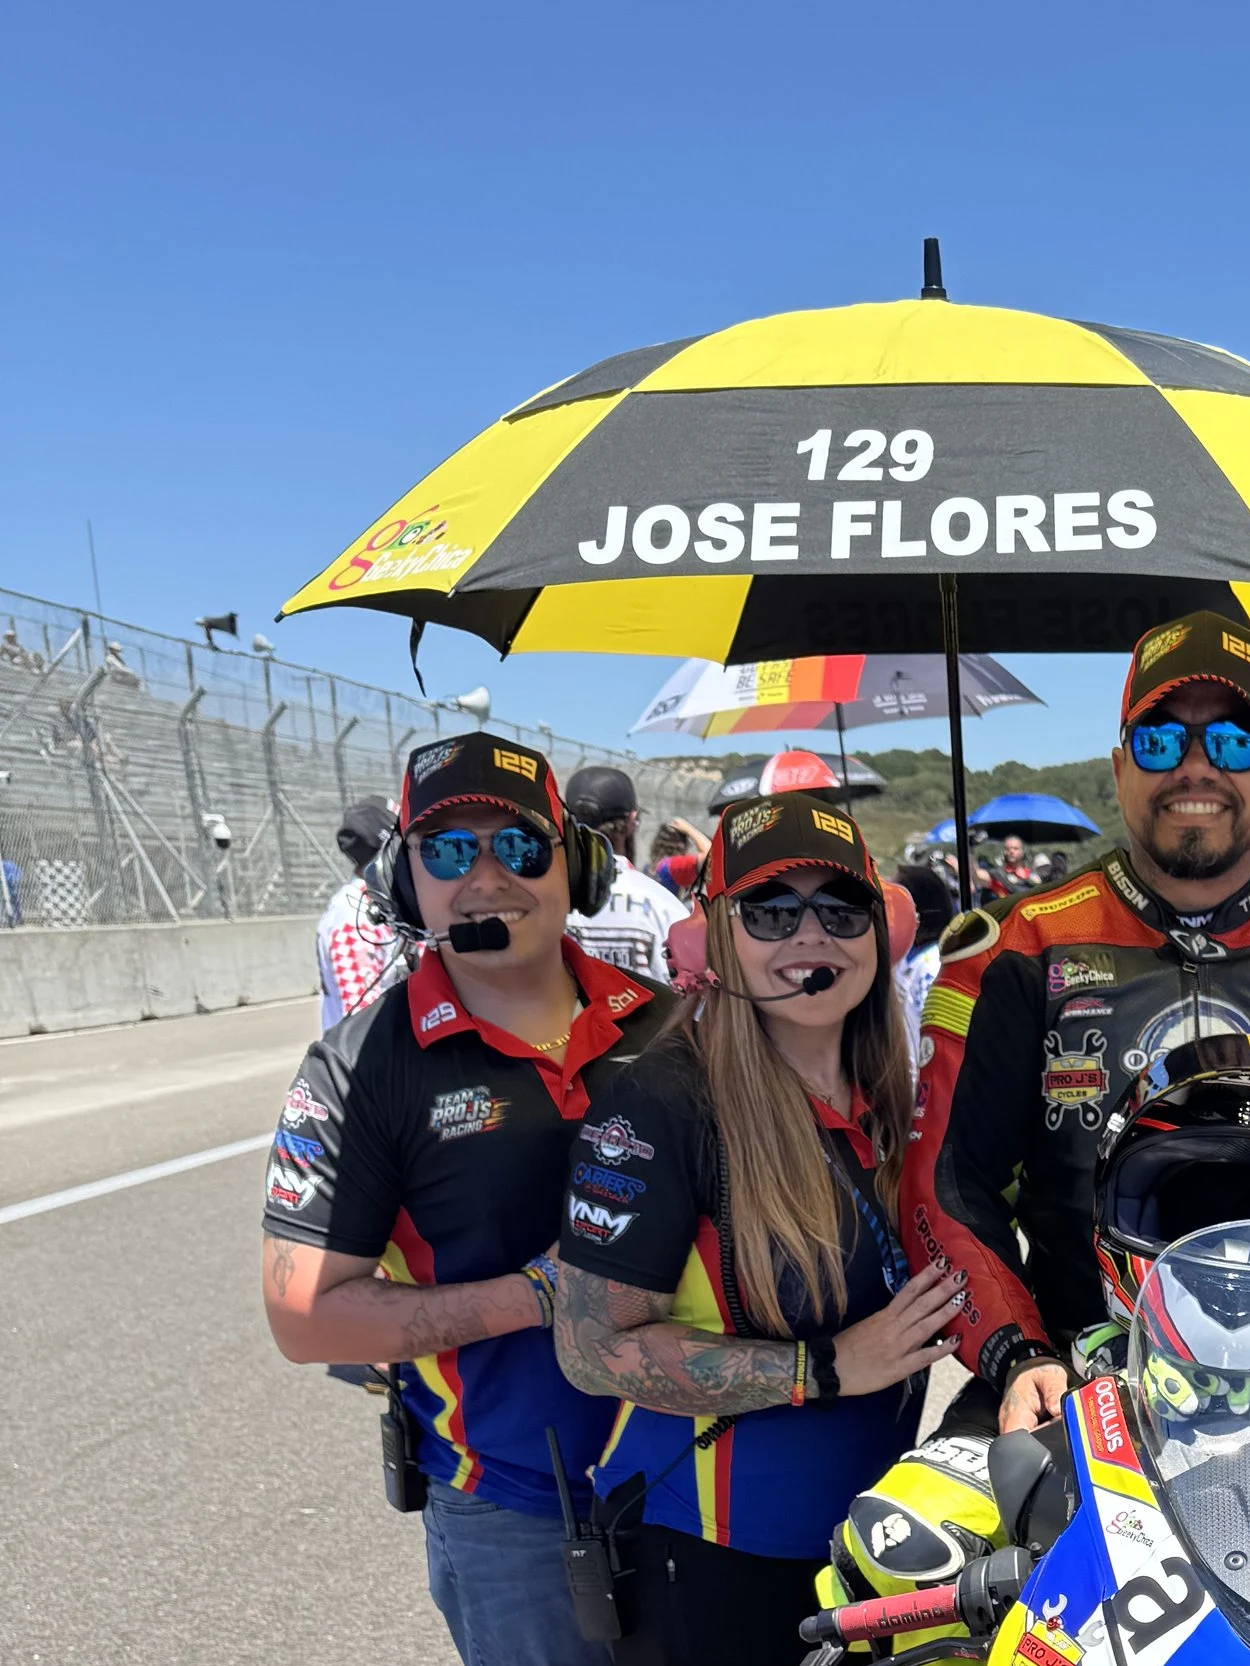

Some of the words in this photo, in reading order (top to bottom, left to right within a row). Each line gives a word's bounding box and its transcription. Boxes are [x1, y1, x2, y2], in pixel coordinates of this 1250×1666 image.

[797, 427, 936, 483] 129
[578, 501, 801, 566] JOSE
[830, 487, 1158, 560] FLORES
[493, 748, 538, 783] 129
[811, 808, 855, 845] 129
[1038, 886, 1096, 912] DUNLOP
[1107, 861, 1149, 911] BISON
[1064, 970, 1114, 987] GeekyChica
[421, 1000, 457, 1032] 129
[1050, 1074, 1073, 1087] PRO
[1057, 1090, 1088, 1099] CYCLES
[435, 1091, 475, 1108] TEAM
[438, 1119, 484, 1142] RACING
[1095, 1381, 1124, 1453] OCULUS
[874, 1600, 942, 1630] domino
[1022, 1637, 1046, 1660] PRO
